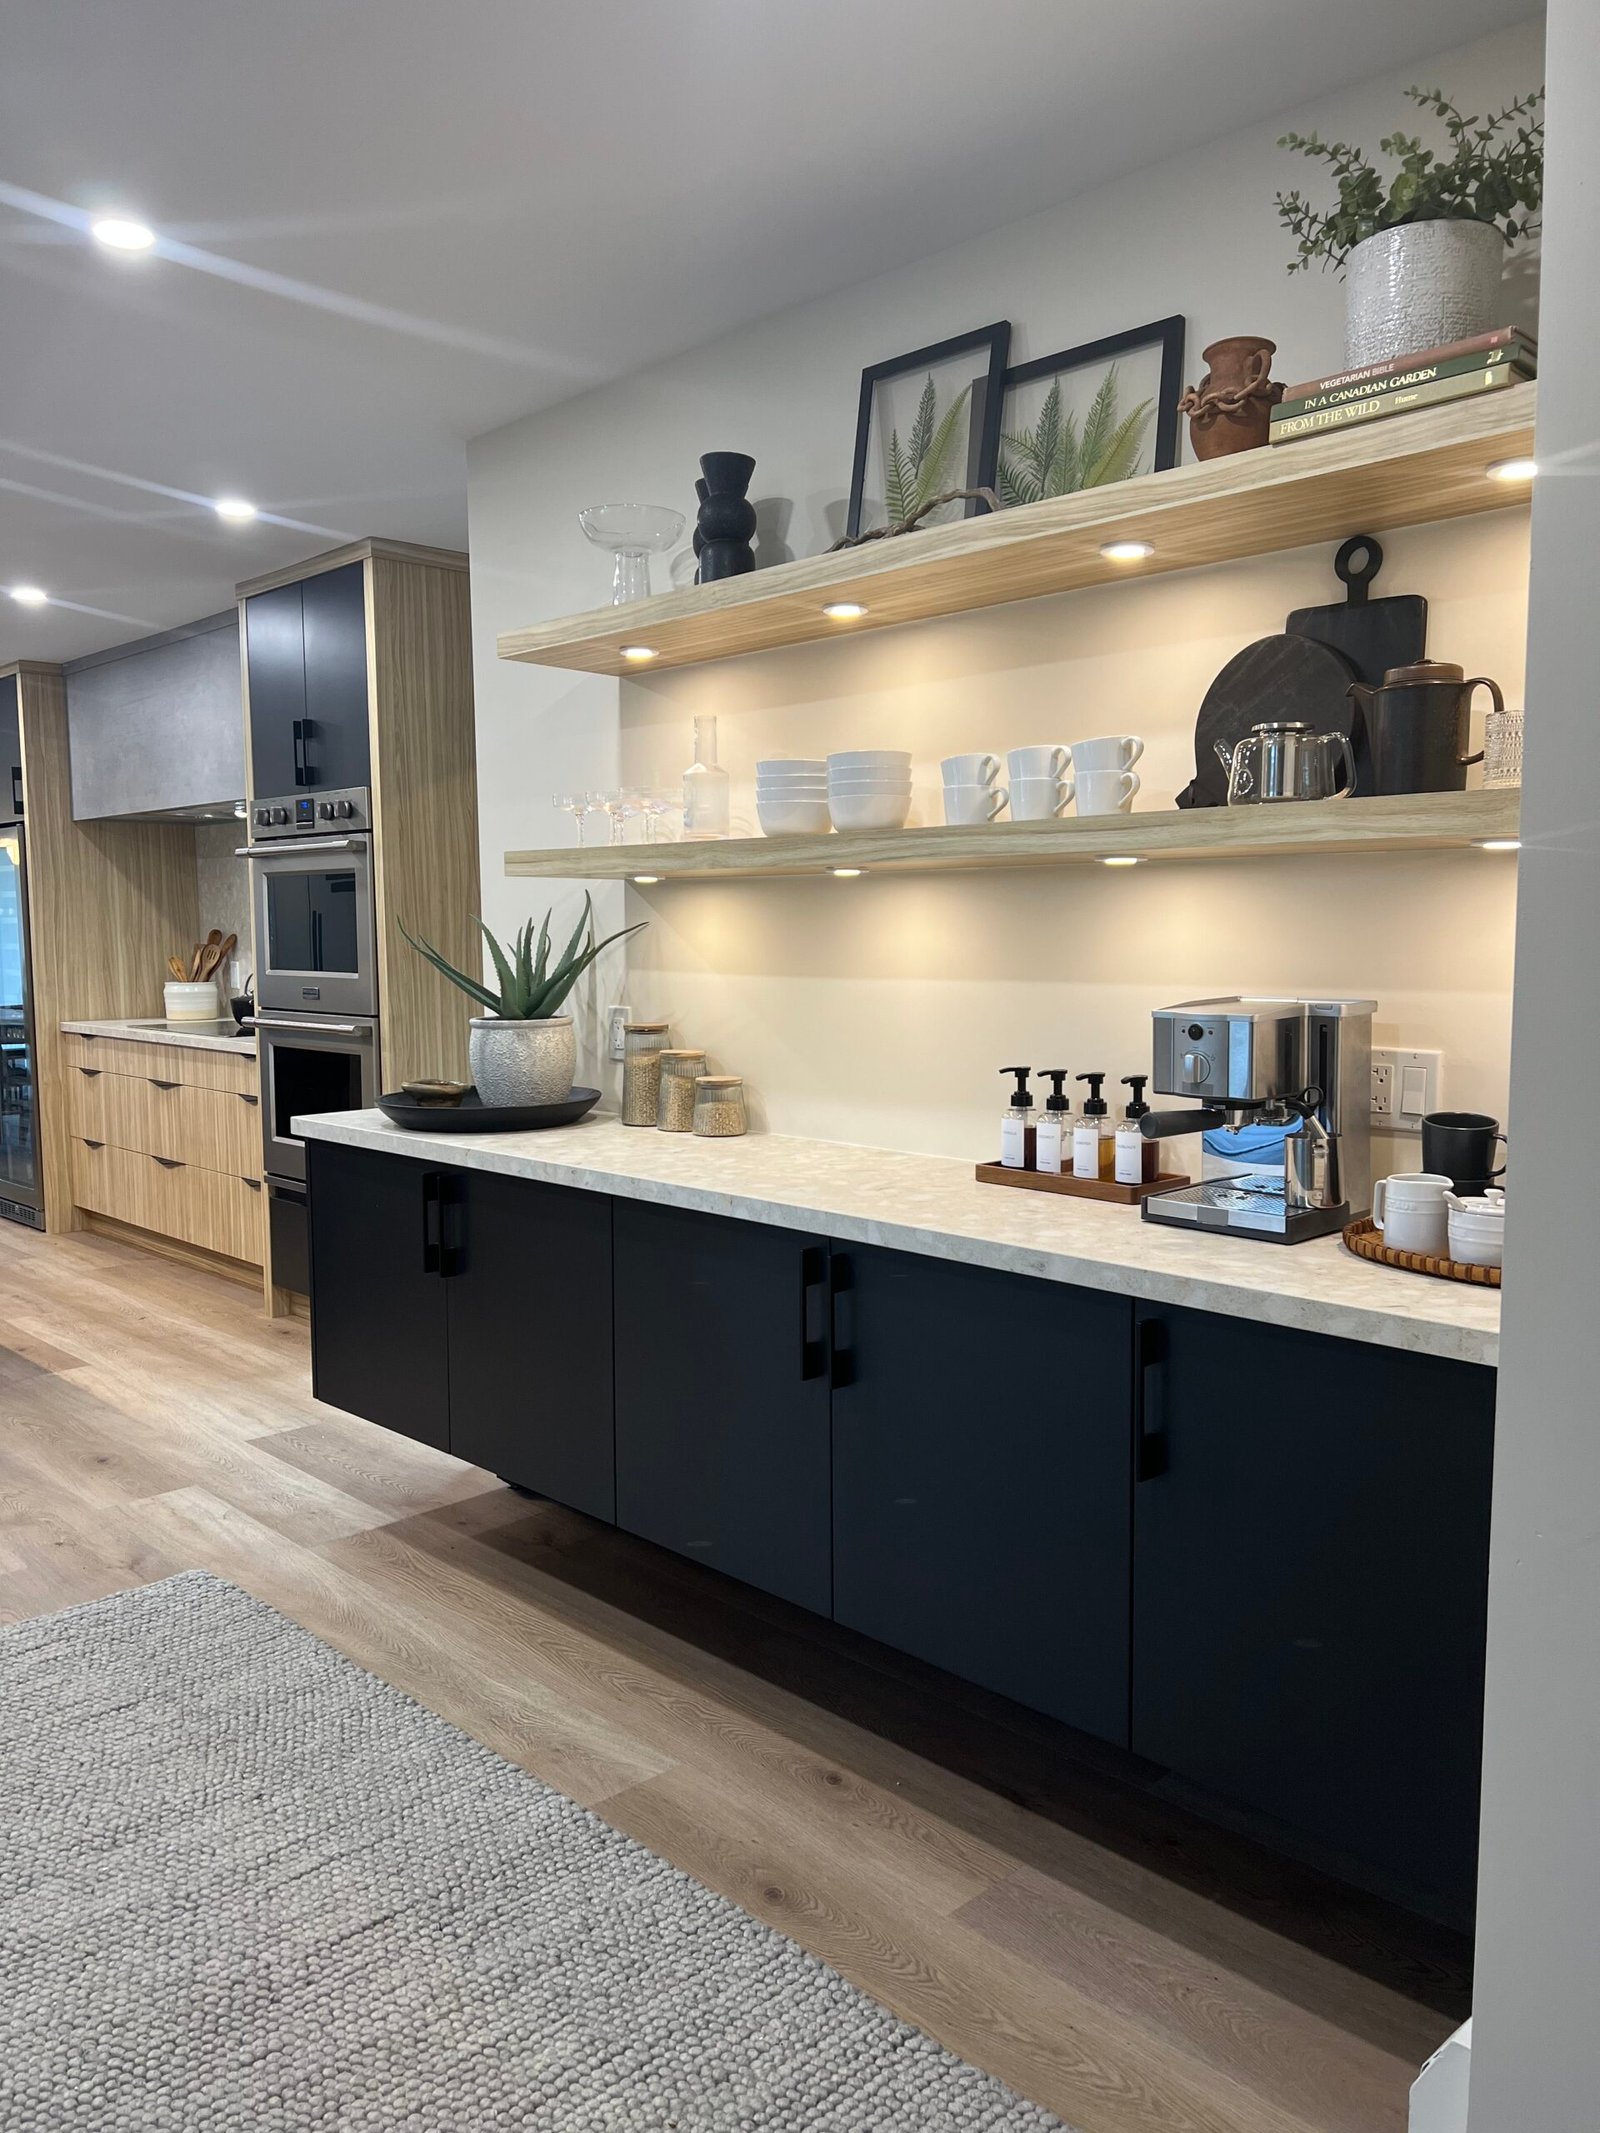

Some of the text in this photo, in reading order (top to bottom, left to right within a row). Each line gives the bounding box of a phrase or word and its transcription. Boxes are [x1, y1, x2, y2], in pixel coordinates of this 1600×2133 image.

[1304, 367, 1437, 409] IN A CANADIAN GARDEN
[1320, 363, 1395, 390] VEGETARIAN BIBLE
[1280, 400, 1380, 435] FROM THE WILD
